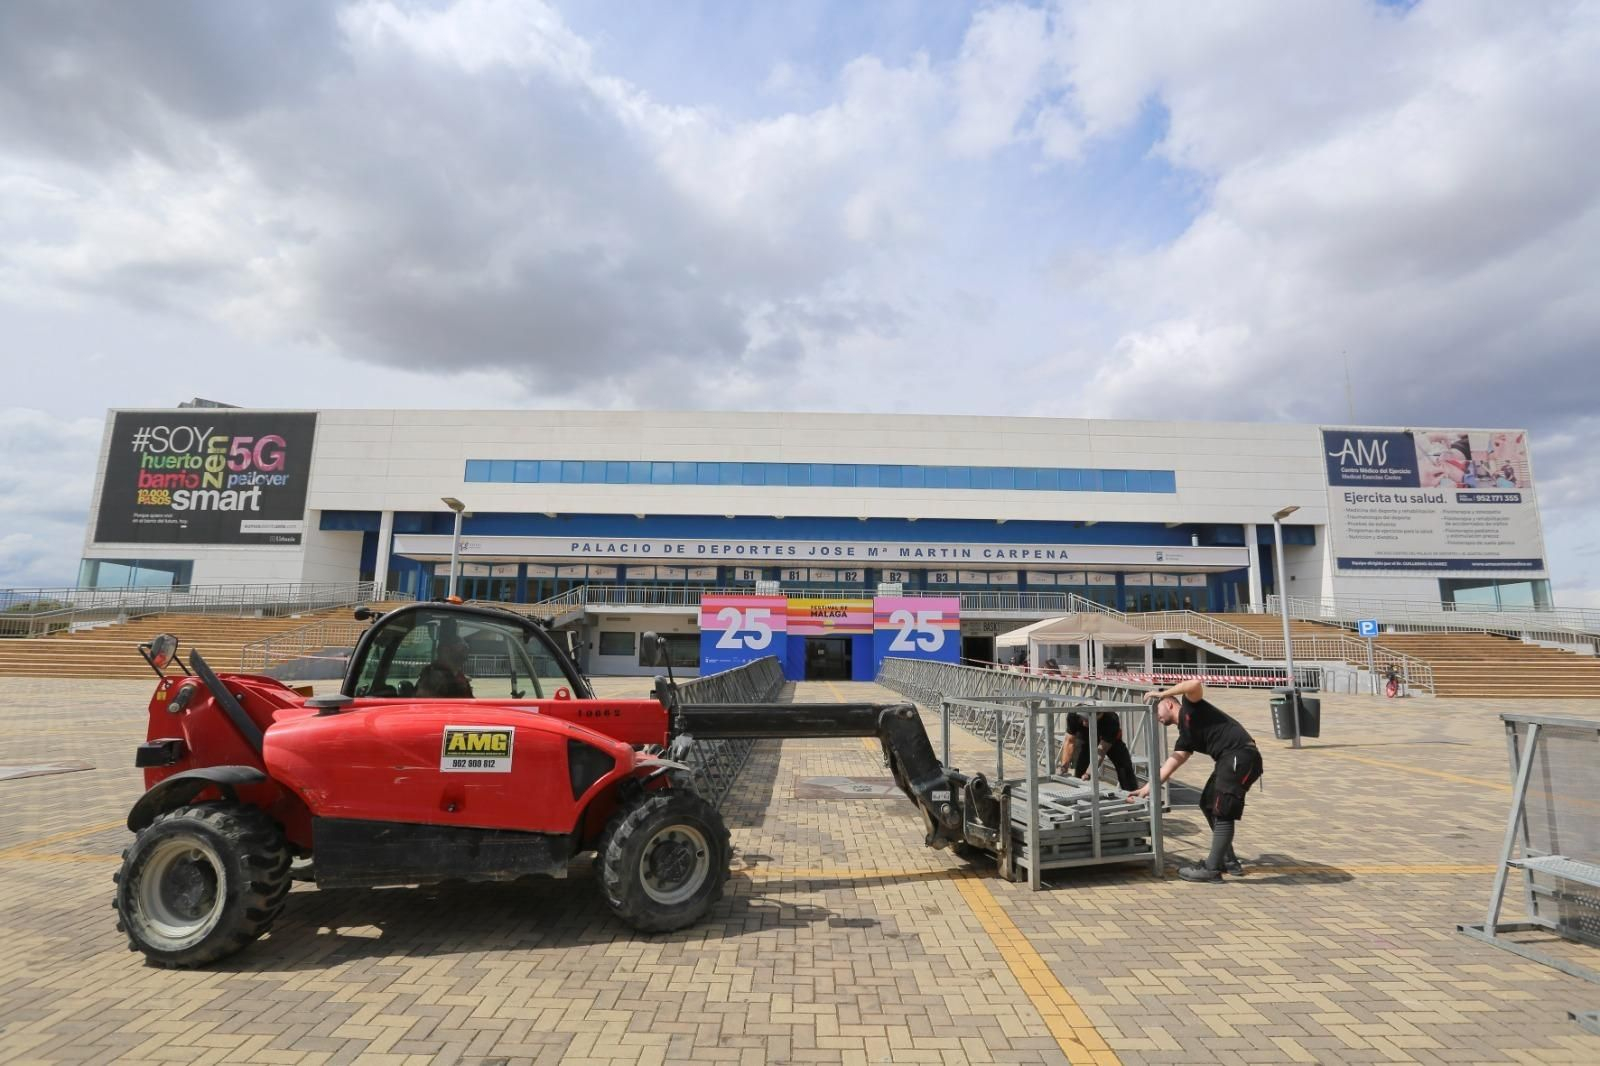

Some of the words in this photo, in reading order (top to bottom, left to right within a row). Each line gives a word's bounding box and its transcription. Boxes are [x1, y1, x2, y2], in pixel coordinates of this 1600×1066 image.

[131, 425, 214, 453] #SOY
[141, 452, 203, 469] huerto
[227, 434, 286, 472] 5G
[1329, 438, 1388, 466] AMS
[138, 468, 200, 488] barrio
[137, 496, 172, 505] PASOS
[171, 485, 262, 511] smart
[1344, 491, 1392, 505] Ejercita
[1394, 493, 1407, 503] tu
[1410, 493, 1448, 504] salud.
[571, 542, 651, 553] PALACIO
[663, 544, 685, 553] DE
[697, 544, 796, 555] DEPORTES
[808, 546, 855, 556] JOSE
[899, 547, 971, 558] MARTIN
[983, 548, 1069, 560] CARPENA
[743, 570, 754, 579] B1
[789, 571, 800, 580] B1
[844, 571, 857, 581] B2
[889, 572, 902, 581] B2
[935, 573, 948, 582] B3
[715, 606, 773, 650] 25
[888, 609, 945, 653] 25
[1361, 621, 1374, 635] P
[447, 732, 508, 751] AMG
